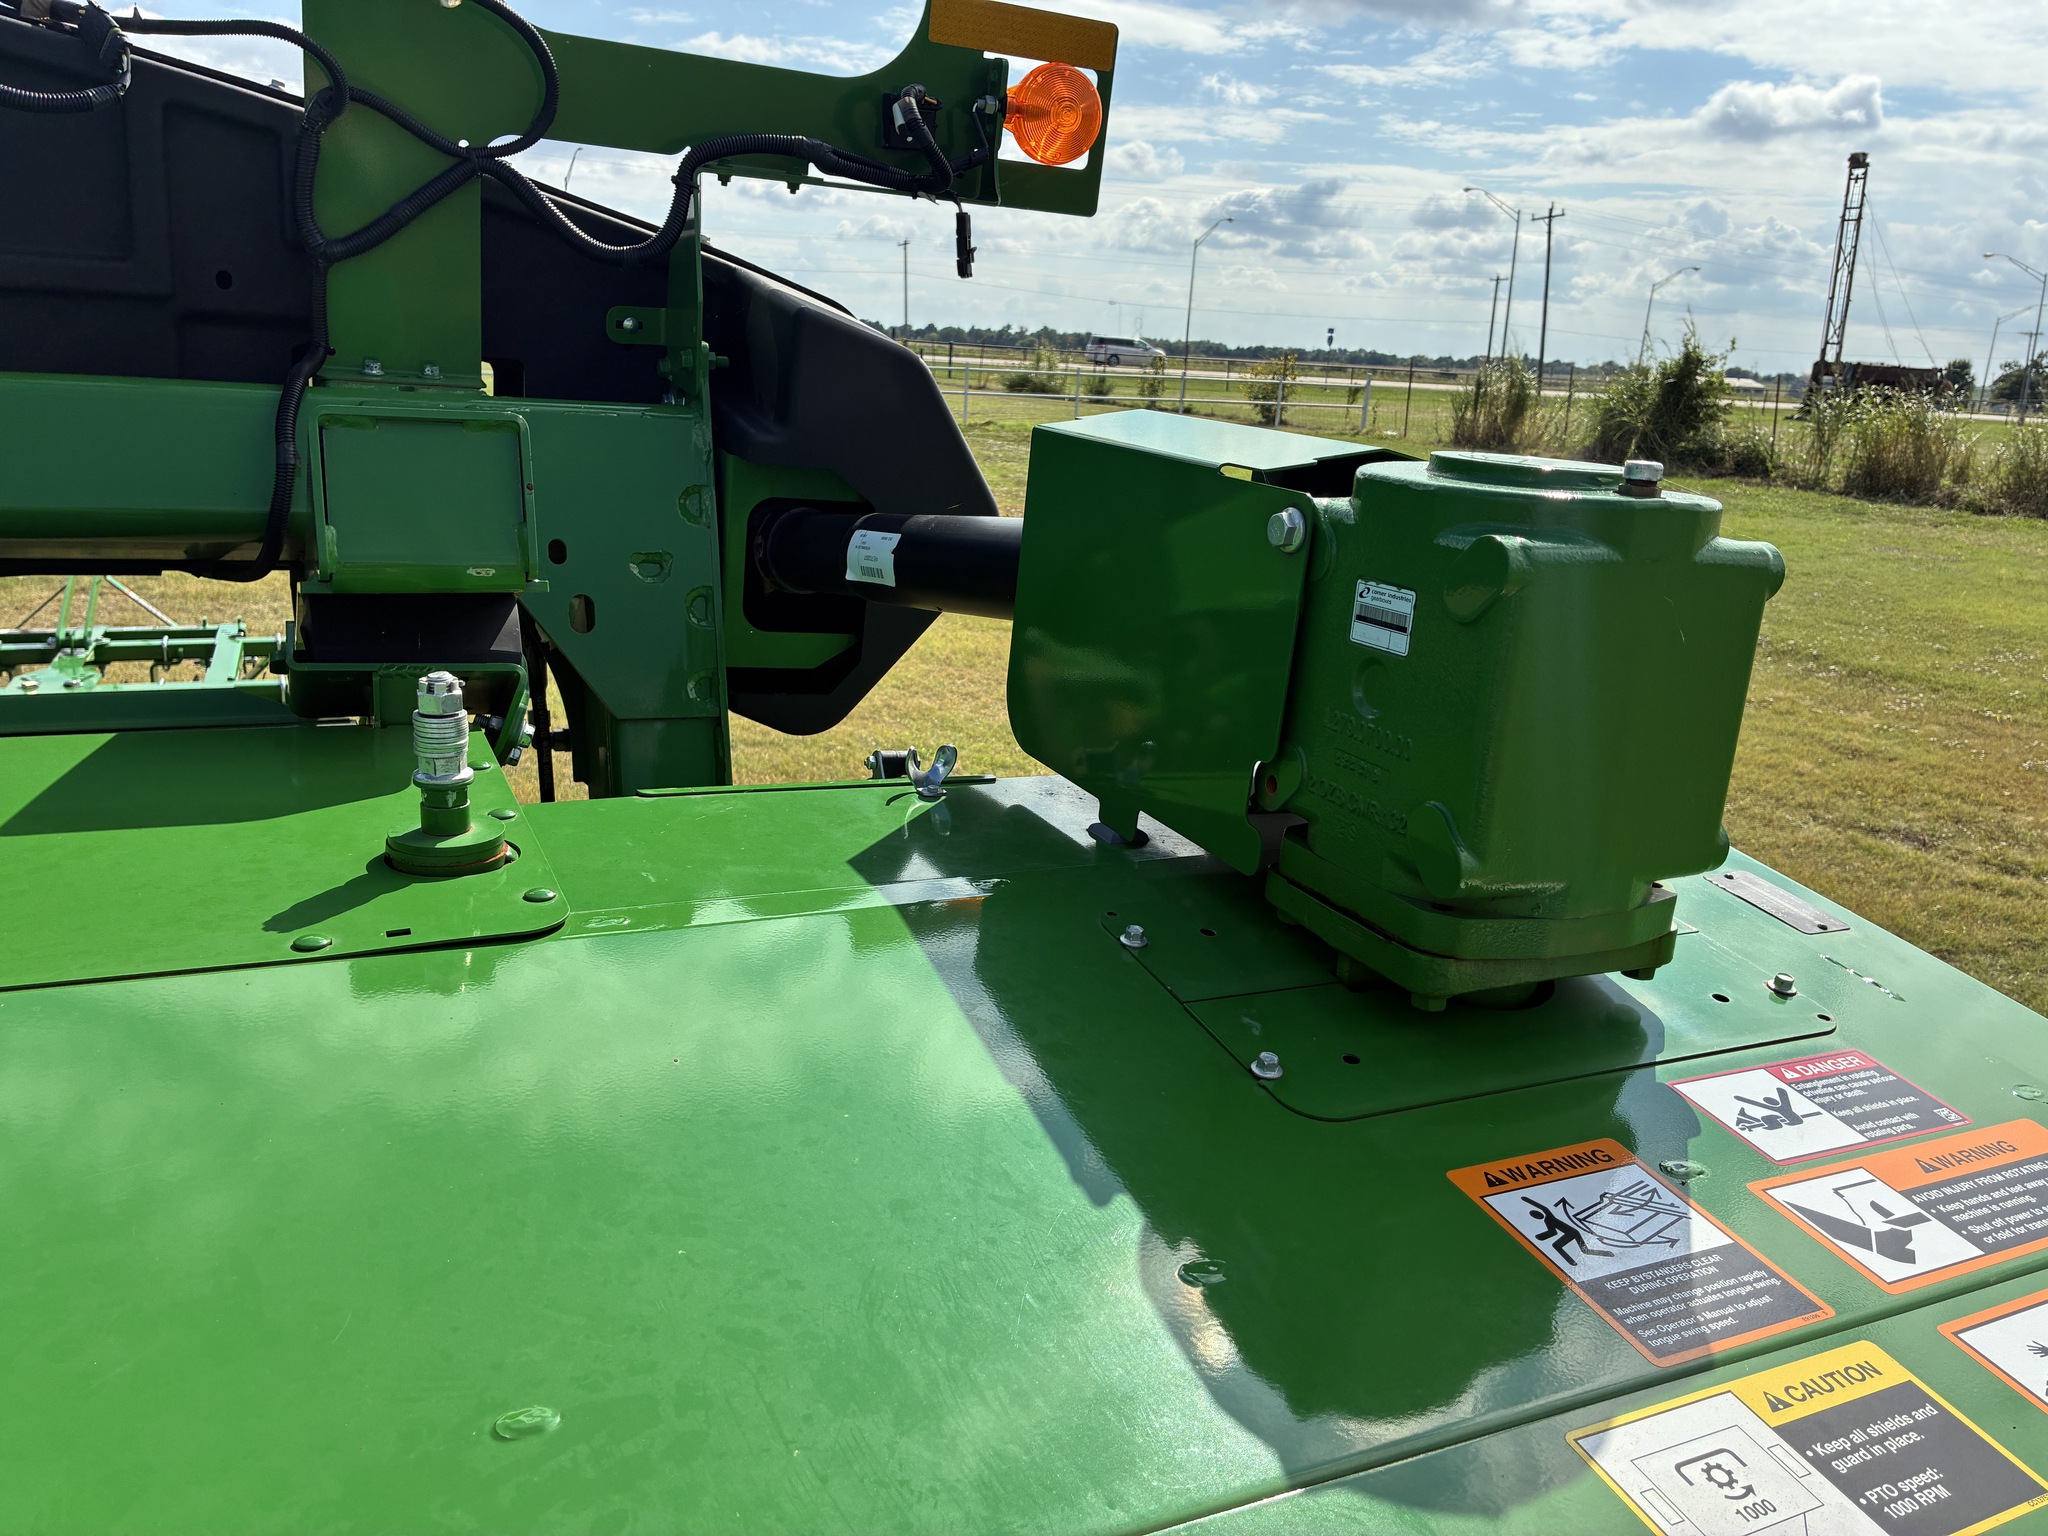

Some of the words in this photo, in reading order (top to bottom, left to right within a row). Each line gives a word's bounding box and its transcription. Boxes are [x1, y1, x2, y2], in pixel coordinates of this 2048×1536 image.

[1372, 589, 1386, 597] comer
[1388, 592, 1412, 603] industries
[1790, 1075, 1843, 1090] Entanglement
[1849, 1070, 1880, 1080] rotating
[1799, 1056, 1866, 1076] DANGER
[1803, 1086, 1836, 1097] driveline
[1848, 1080, 1871, 1088] cause
[1869, 1074, 1897, 1084] serious
[1810, 1096, 1837, 1104] injury
[1843, 1089, 1868, 1098] death.
[1830, 1108, 1855, 1117] Keep
[1862, 1101, 1890, 1111] shields
[1896, 1096, 1920, 1106] place.
[1852, 1121, 1878, 1131] Avoid
[1875, 1116, 1905, 1126] contact
[1900, 1112, 1920, 1120] with
[1864, 1128, 1897, 1138] rotating
[1892, 1123, 1917, 1133] parts.
[1499, 1149, 1616, 1182] WARNING
[1929, 1141, 2019, 1169] WARNING
[1912, 1190, 1945, 1204] AVOID
[1940, 1180, 1978, 1196] INJURY
[1974, 1173, 2006, 1186] FROM
[2001, 1162, 2048, 1178] ROTATING
[1936, 1200, 1965, 1213] Keep
[1960, 1194, 1992, 1207] hands
[1990, 1188, 2009, 1198] and
[2005, 1184, 2027, 1194] feet
[2024, 1178, 2048, 1189] away
[1952, 1207, 1992, 1222] machine
[1999, 1195, 2037, 1209] running.
[1967, 1222, 1994, 1234] Shut
[1992, 1217, 2007, 1227] off
[2004, 1211, 2034, 1225] power
[1983, 1235, 1996, 1244] or
[1992, 1228, 2015, 1240] fold
[2010, 1226, 2028, 1235] for
[1604, 1277, 1630, 1290] KEEP
[1630, 1262, 1692, 1283] BYSTANDERS
[1691, 1254, 1723, 1268] CLEAR
[1629, 1279, 1666, 1294] DURING
[1665, 1265, 1719, 1284] OPERATION
[1613, 1300, 1653, 1316] Machine
[1652, 1296, 1673, 1306] may
[1672, 1287, 1705, 1300] change
[1703, 1278, 1740, 1293] position
[1738, 1270, 1768, 1282] rapidly
[1624, 1312, 1650, 1325] when
[1650, 1302, 1687, 1318] operator
[1687, 1292, 1724, 1307] actuates
[1722, 1284, 1754, 1298] tongue
[1753, 1278, 1782, 1288] swing.
[1638, 1329, 1657, 1338] See
[1702, 1305, 1737, 1320] Manual
[1733, 1303, 1746, 1311] to
[1745, 1294, 1774, 1308] adjust
[1648, 1333, 1682, 1347] tongue
[1681, 1325, 1711, 1338] swing
[1708, 1316, 1739, 1330] speed.
[1784, 1360, 1883, 1402] CAUTION
[1812, 1437, 1852, 1456] Keep
[1850, 1429, 1869, 1443] all
[1866, 1414, 1913, 1438] shields
[1911, 1403, 1939, 1420] and
[1831, 1448, 1872, 1474] guard
[1867, 1444, 1887, 1456] in
[1884, 1430, 1925, 1454] place.
[1864, 1483, 1899, 1504] PTO
[1897, 1467, 1944, 1494] speed:
[1735, 1499, 1777, 1522] 1000
[1884, 1498, 1920, 1519] 1000
[1914, 1484, 1952, 1506] RPM
